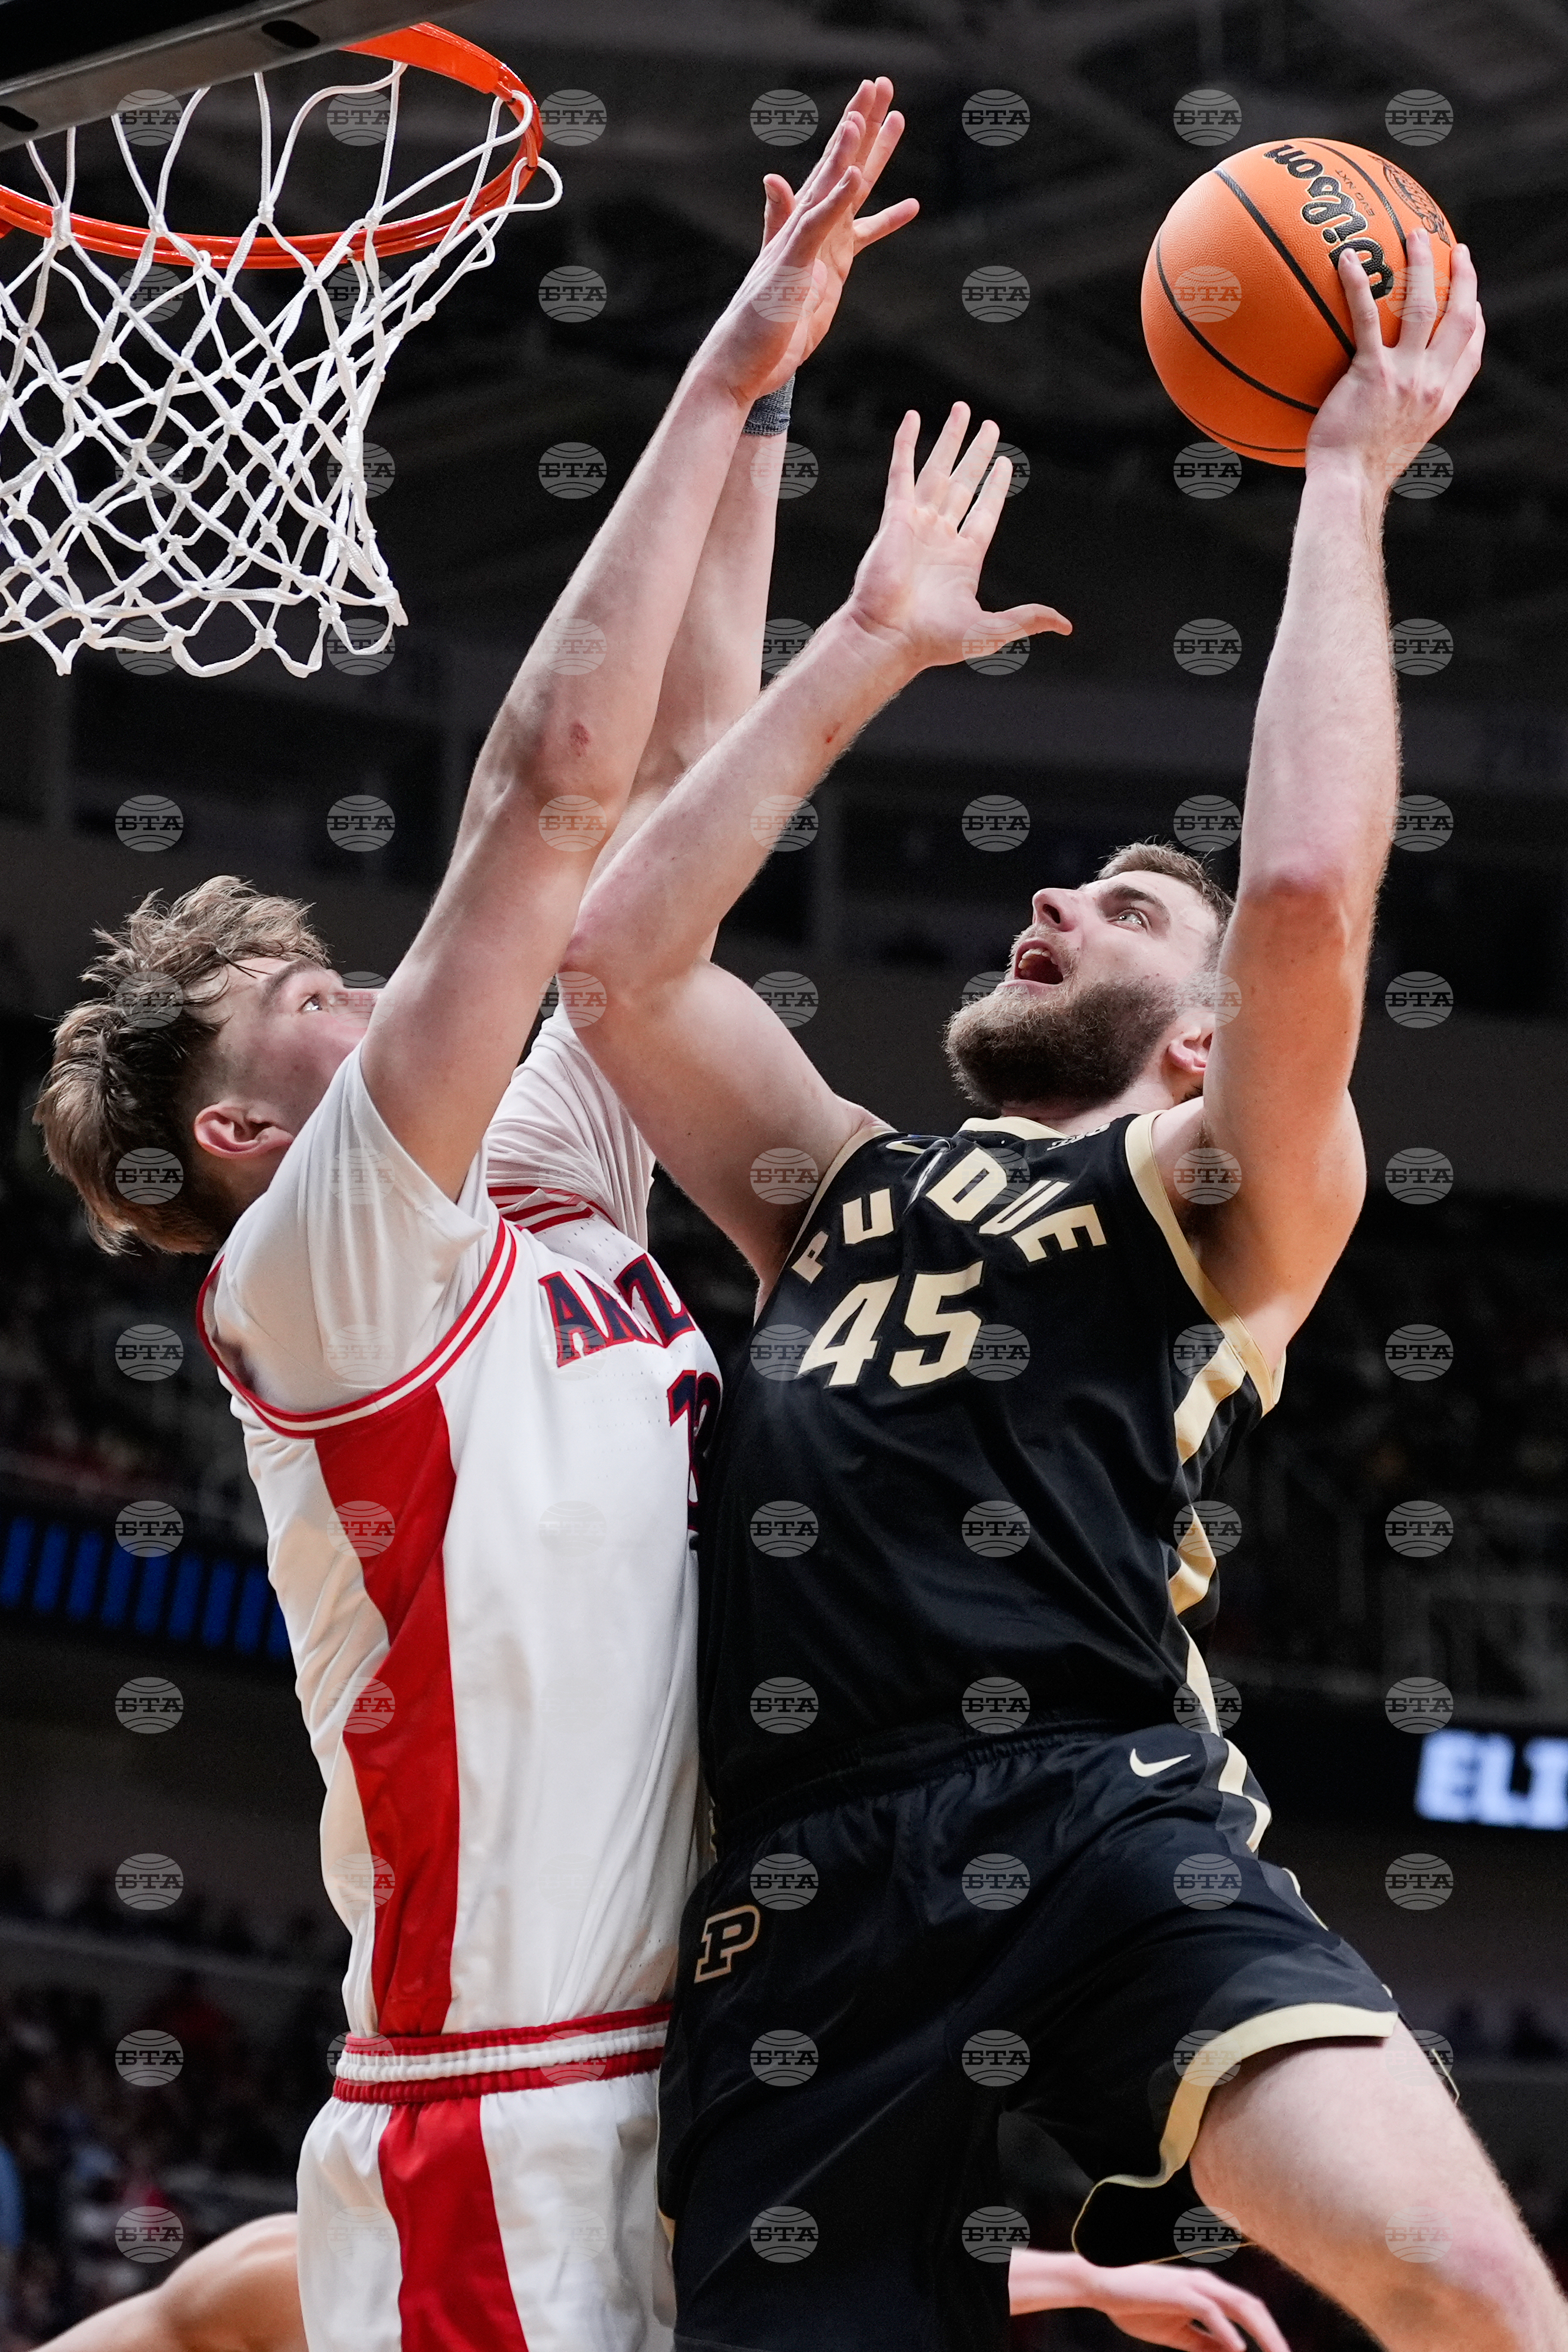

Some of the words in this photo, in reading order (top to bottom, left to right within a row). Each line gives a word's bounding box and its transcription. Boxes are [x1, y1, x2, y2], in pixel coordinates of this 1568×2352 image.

[1335, 169, 1356, 189] NXT
[1356, 192, 1375, 216] EVO
[791, 1147, 1108, 1284] PUDUE
[795, 1260, 984, 1388] 45
[1263, 1320, 1394, 1476] Wilson
[694, 1905, 761, 1984] P
